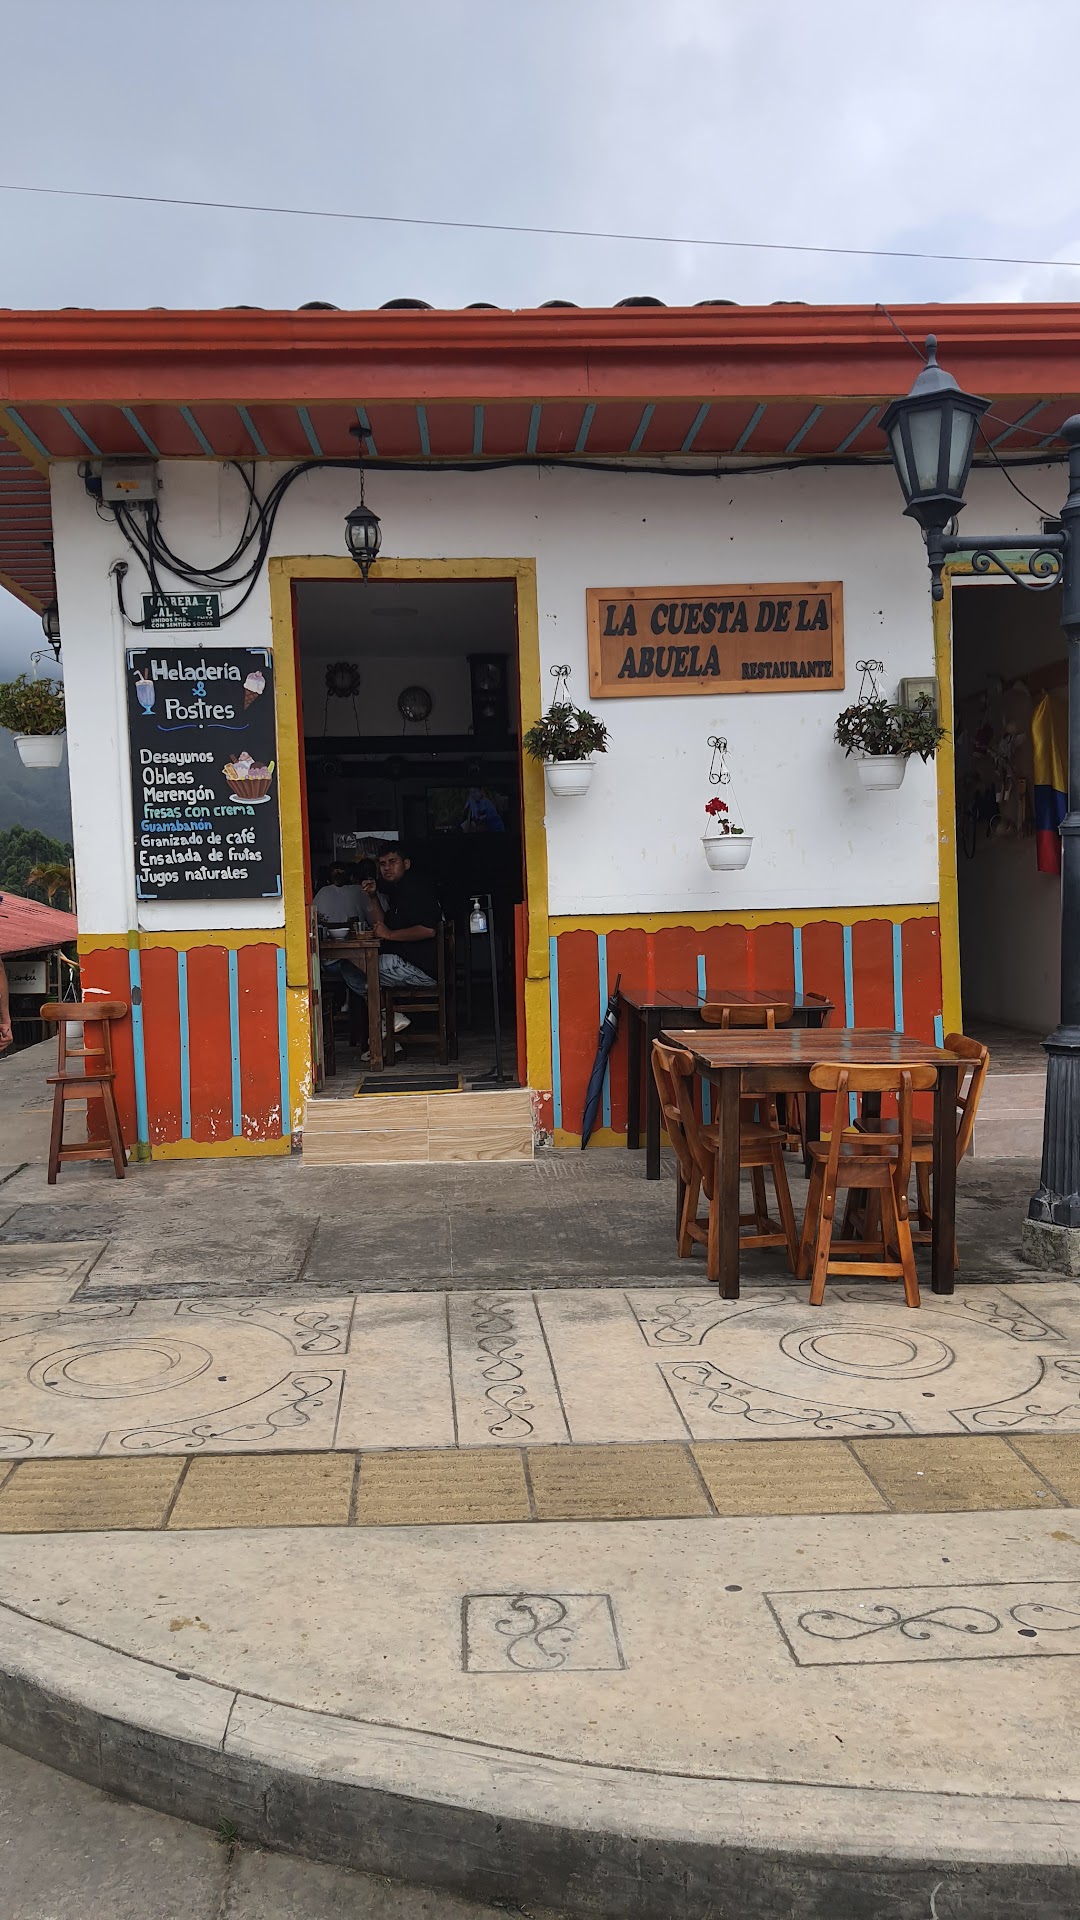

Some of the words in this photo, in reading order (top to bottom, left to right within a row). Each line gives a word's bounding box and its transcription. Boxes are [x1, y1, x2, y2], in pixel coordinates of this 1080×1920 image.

[206, 597, 211, 605] 7
[206, 607, 213, 615] 5
[603, 604, 638, 636] LA
[650, 601, 749, 635] CUESTA
[755, 600, 792, 632] DE
[795, 599, 829, 631] LA
[618, 644, 720, 679] ABUELA
[741, 660, 832, 680] RESTAURANTE
[165, 698, 235, 720] Postres
[140, 748, 214, 766] Desayunos
[142, 767, 194, 785] Obleas
[143, 785, 215, 805] Merengón
[185, 806, 210, 818] con
[214, 805, 255, 817] crema
[141, 832, 203, 847] Granizado
[207, 832, 221, 844] de
[226, 827, 256, 844] café
[140, 848, 202, 866] Ensalada
[208, 849, 223, 862] de
[140, 868, 179, 887] Jugos
[185, 866, 248, 880] naturales
